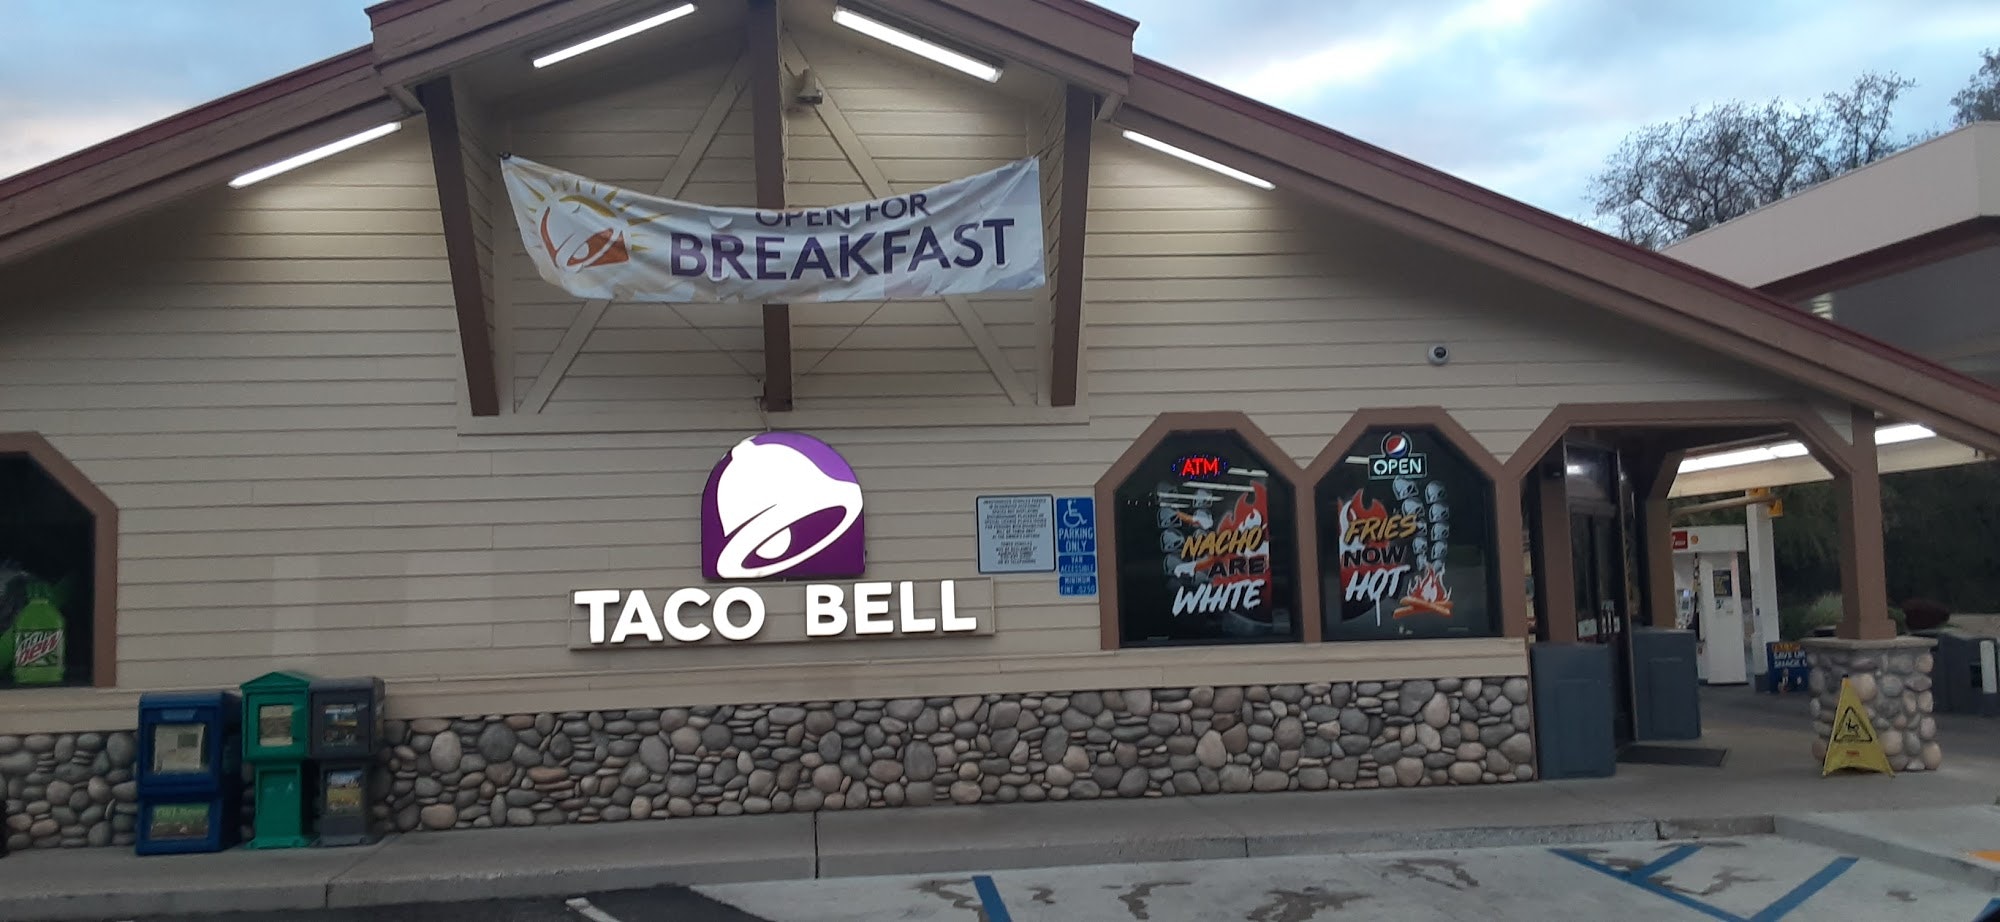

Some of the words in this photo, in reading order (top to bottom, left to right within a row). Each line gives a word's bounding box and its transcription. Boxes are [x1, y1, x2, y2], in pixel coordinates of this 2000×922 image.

[865, 194, 930, 223] FOR
[670, 218, 1015, 281] BREAKFAST
[1182, 457, 1219, 477] ATM
[1373, 458, 1422, 475] OPEN
[1058, 527, 1094, 540] PARKING
[1345, 517, 1417, 545] FRIES
[1065, 540, 1087, 552] ONLY
[1181, 529, 1262, 560] NACHO
[1070, 555, 1083, 563] VAN
[1209, 557, 1265, 578] ARE
[1345, 547, 1403, 568] NOW
[1173, 580, 1264, 617] WHITE
[1345, 564, 1411, 627] HOT
[574, 588, 766, 644] TACO
[805, 579, 978, 637] BELL
